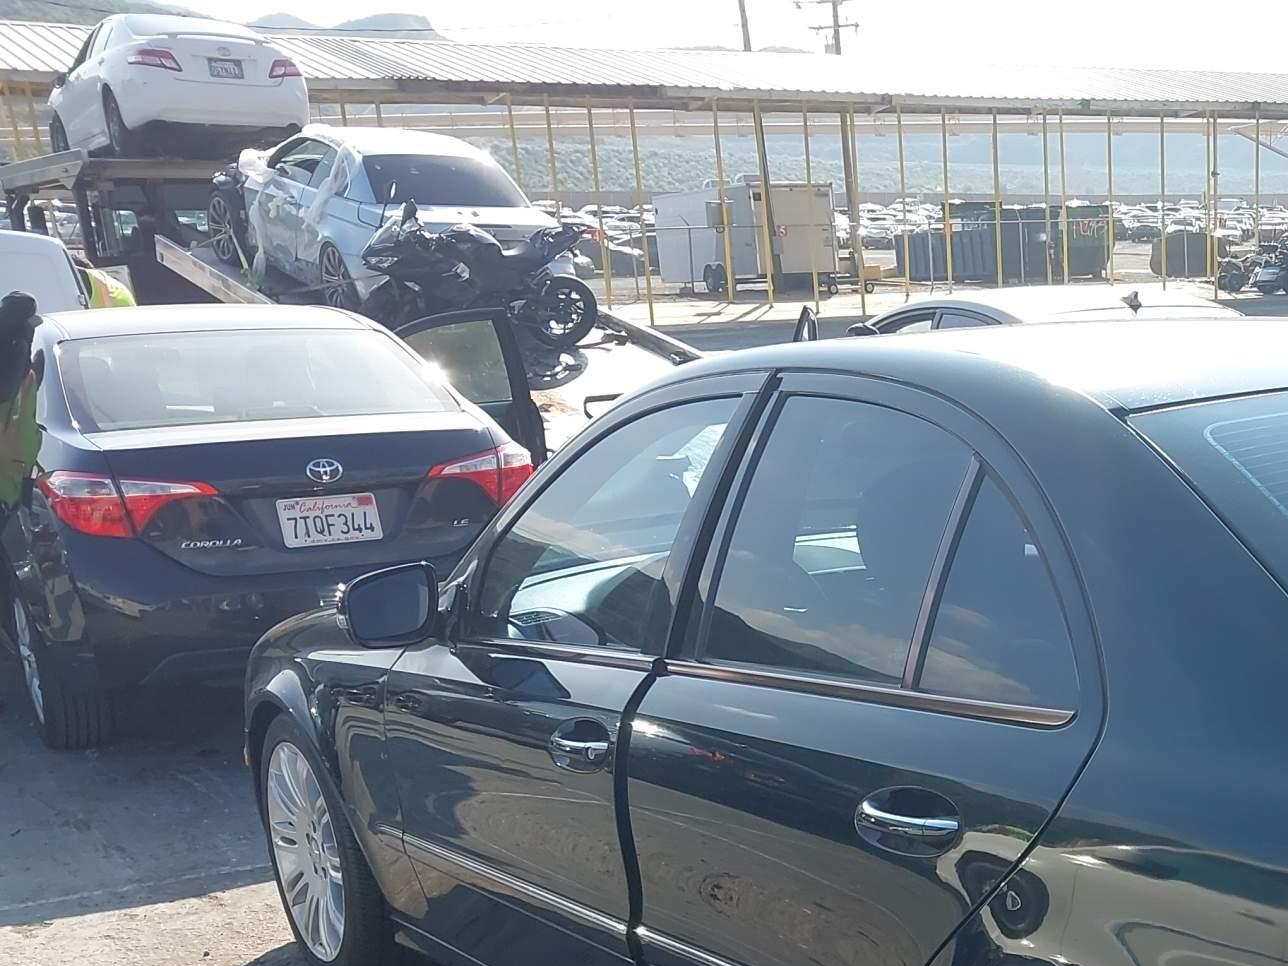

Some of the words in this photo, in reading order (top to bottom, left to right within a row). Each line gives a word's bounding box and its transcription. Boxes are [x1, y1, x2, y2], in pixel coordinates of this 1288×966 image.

[299, 501, 357, 514] California
[287, 512, 375, 540] 7TQF344
[181, 538, 242, 549] COROLLA
